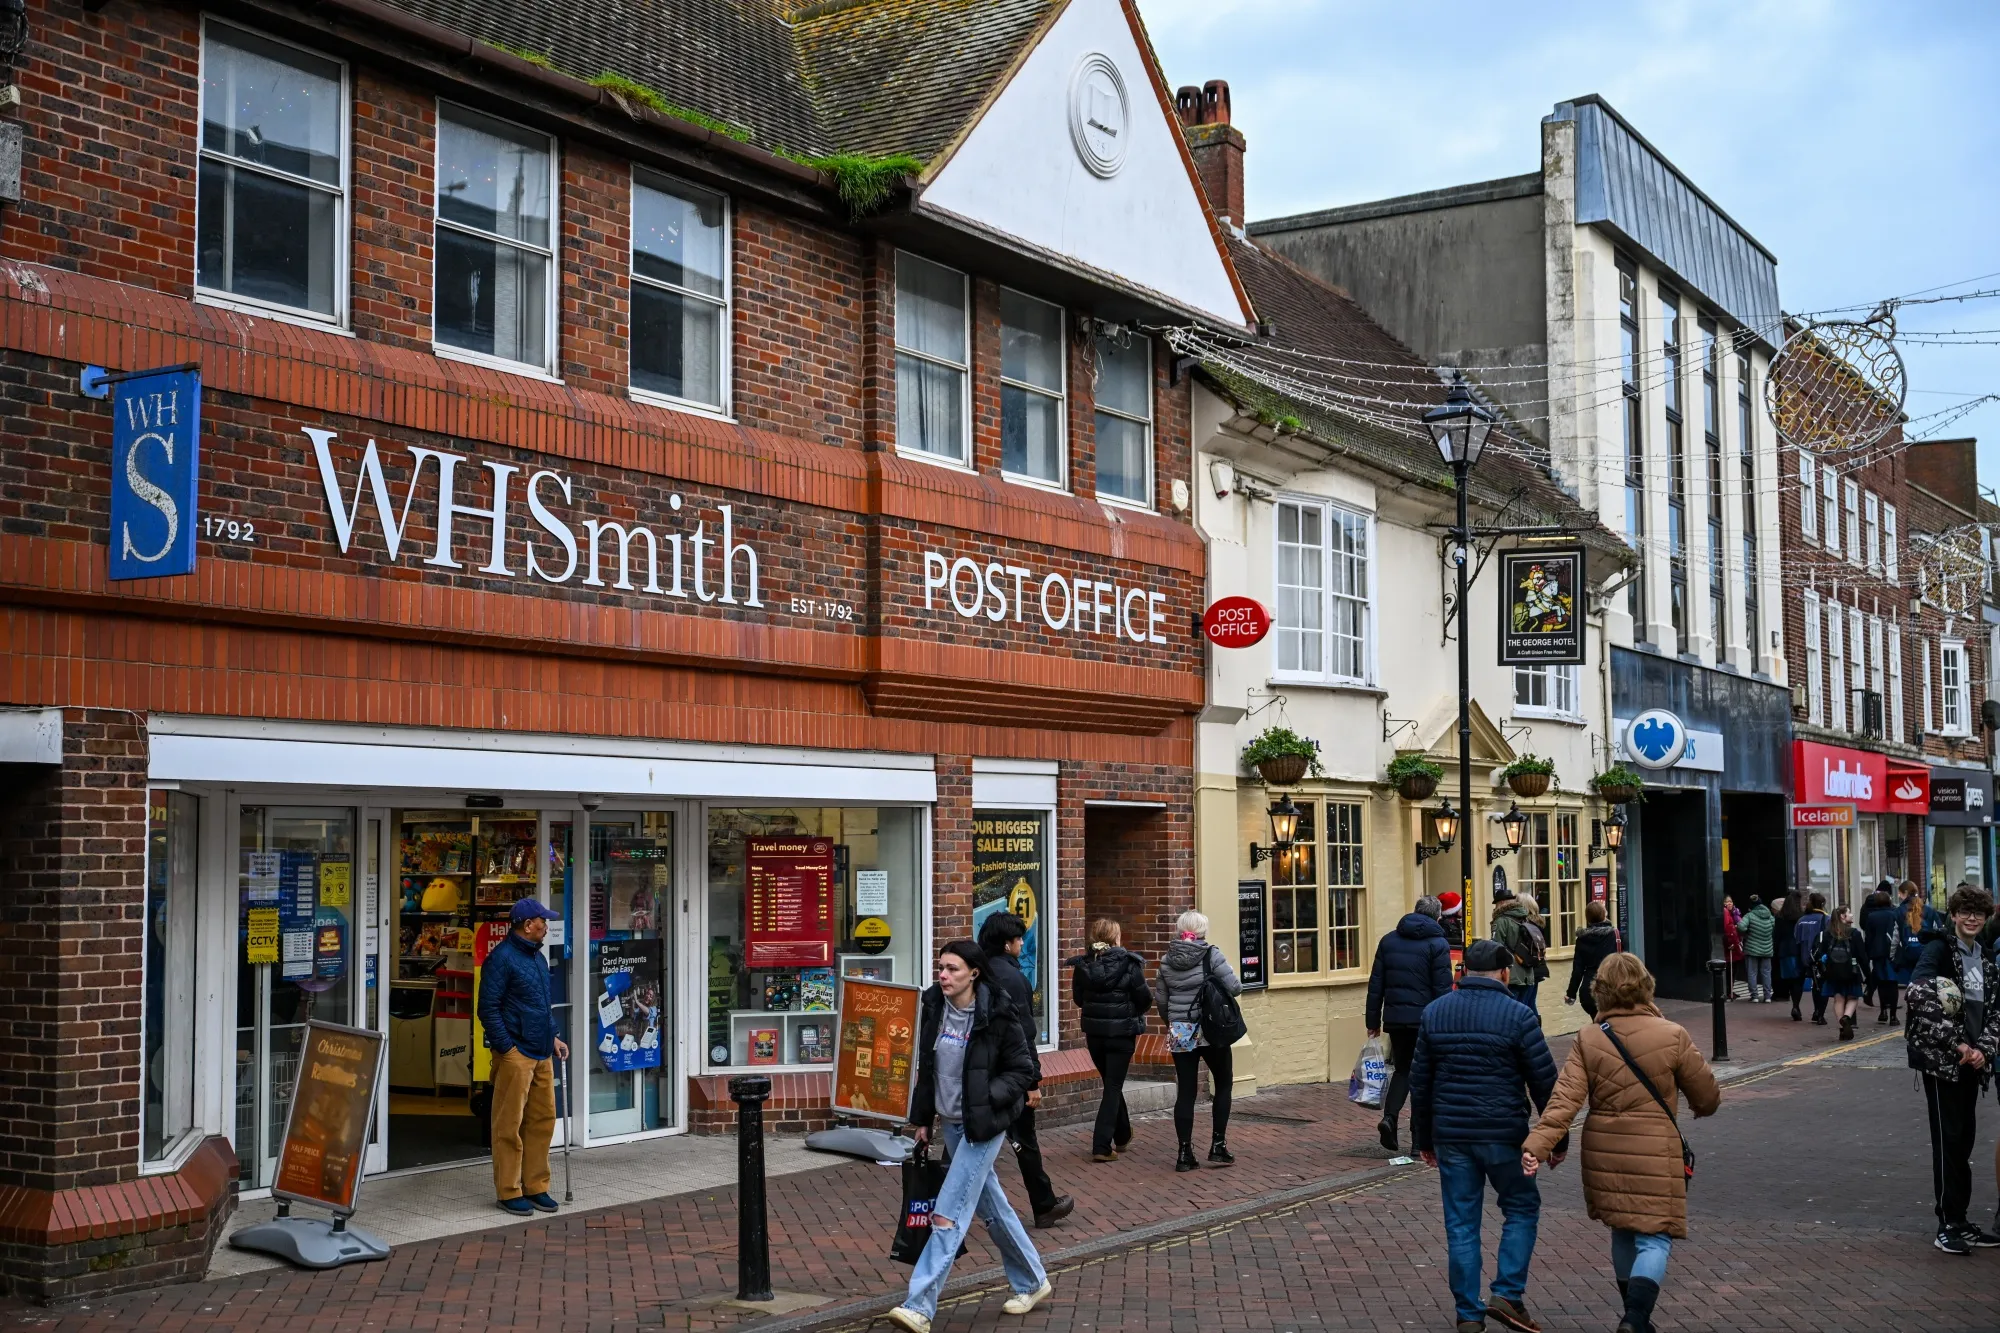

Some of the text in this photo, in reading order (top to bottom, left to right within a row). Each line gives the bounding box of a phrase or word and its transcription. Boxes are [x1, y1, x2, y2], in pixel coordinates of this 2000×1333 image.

[125, 390, 178, 431] WH
[122, 432, 178, 562] S
[301, 426, 765, 609] WHSmith
[204, 517, 254, 542] 1792
[924, 550, 1167, 645] POST OFFICE
[1218, 608, 1253, 622] POST
[1210, 622, 1258, 637] OFFICE
[1553, 638, 1576, 646] HOTEL
[1937, 786, 1958, 795] vision
[1933, 794, 1962, 803] express
[1797, 810, 1848, 823] Iceland
[972, 821, 1041, 835] OUR BIGGEST
[751, 842, 808, 854] Travel money
[977, 838, 1034, 852] SALE EVER
[981, 861, 1007, 872] Fashion
[1007, 861, 1040, 872] Stationery
[1015, 897, 1030, 919] £1
[250, 935, 276, 946] CCTV
[602, 955, 647, 966] Card Payments
[602, 964, 634, 975] Made Easy
[816, 989, 831, 999] Atlas
[855, 991, 903, 1006] BOOK CLUB
[888, 1025, 897, 1036] 3
[900, 1026, 909, 1038] 2
[439, 1044, 467, 1058] Energizer
